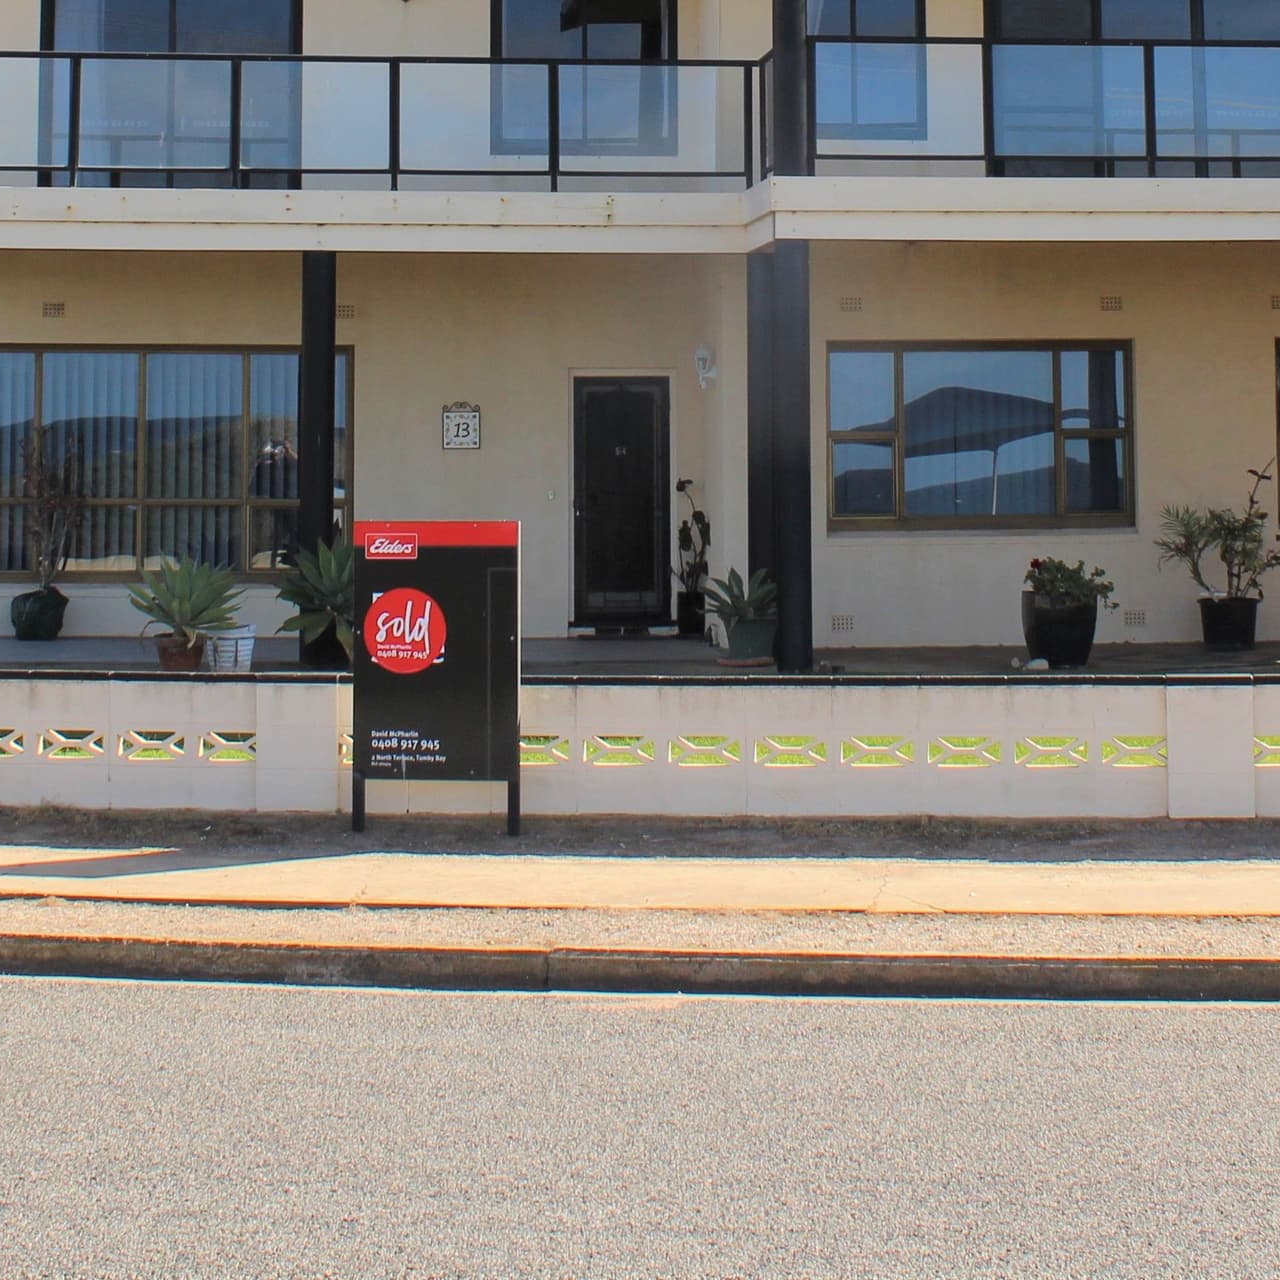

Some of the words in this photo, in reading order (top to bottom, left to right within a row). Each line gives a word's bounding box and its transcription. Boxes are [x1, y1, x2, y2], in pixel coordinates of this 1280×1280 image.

[453, 422, 470, 438] 13
[370, 538, 414, 554] Elders
[375, 600, 432, 655] sold
[377, 650, 397, 658] 0408
[398, 650, 412, 659] 917
[412, 650, 428, 659] 945
[371, 738, 399, 750] 0408
[400, 739, 419, 751] 917
[420, 739, 440, 751] 945
[435, 754, 447, 762] Bay
